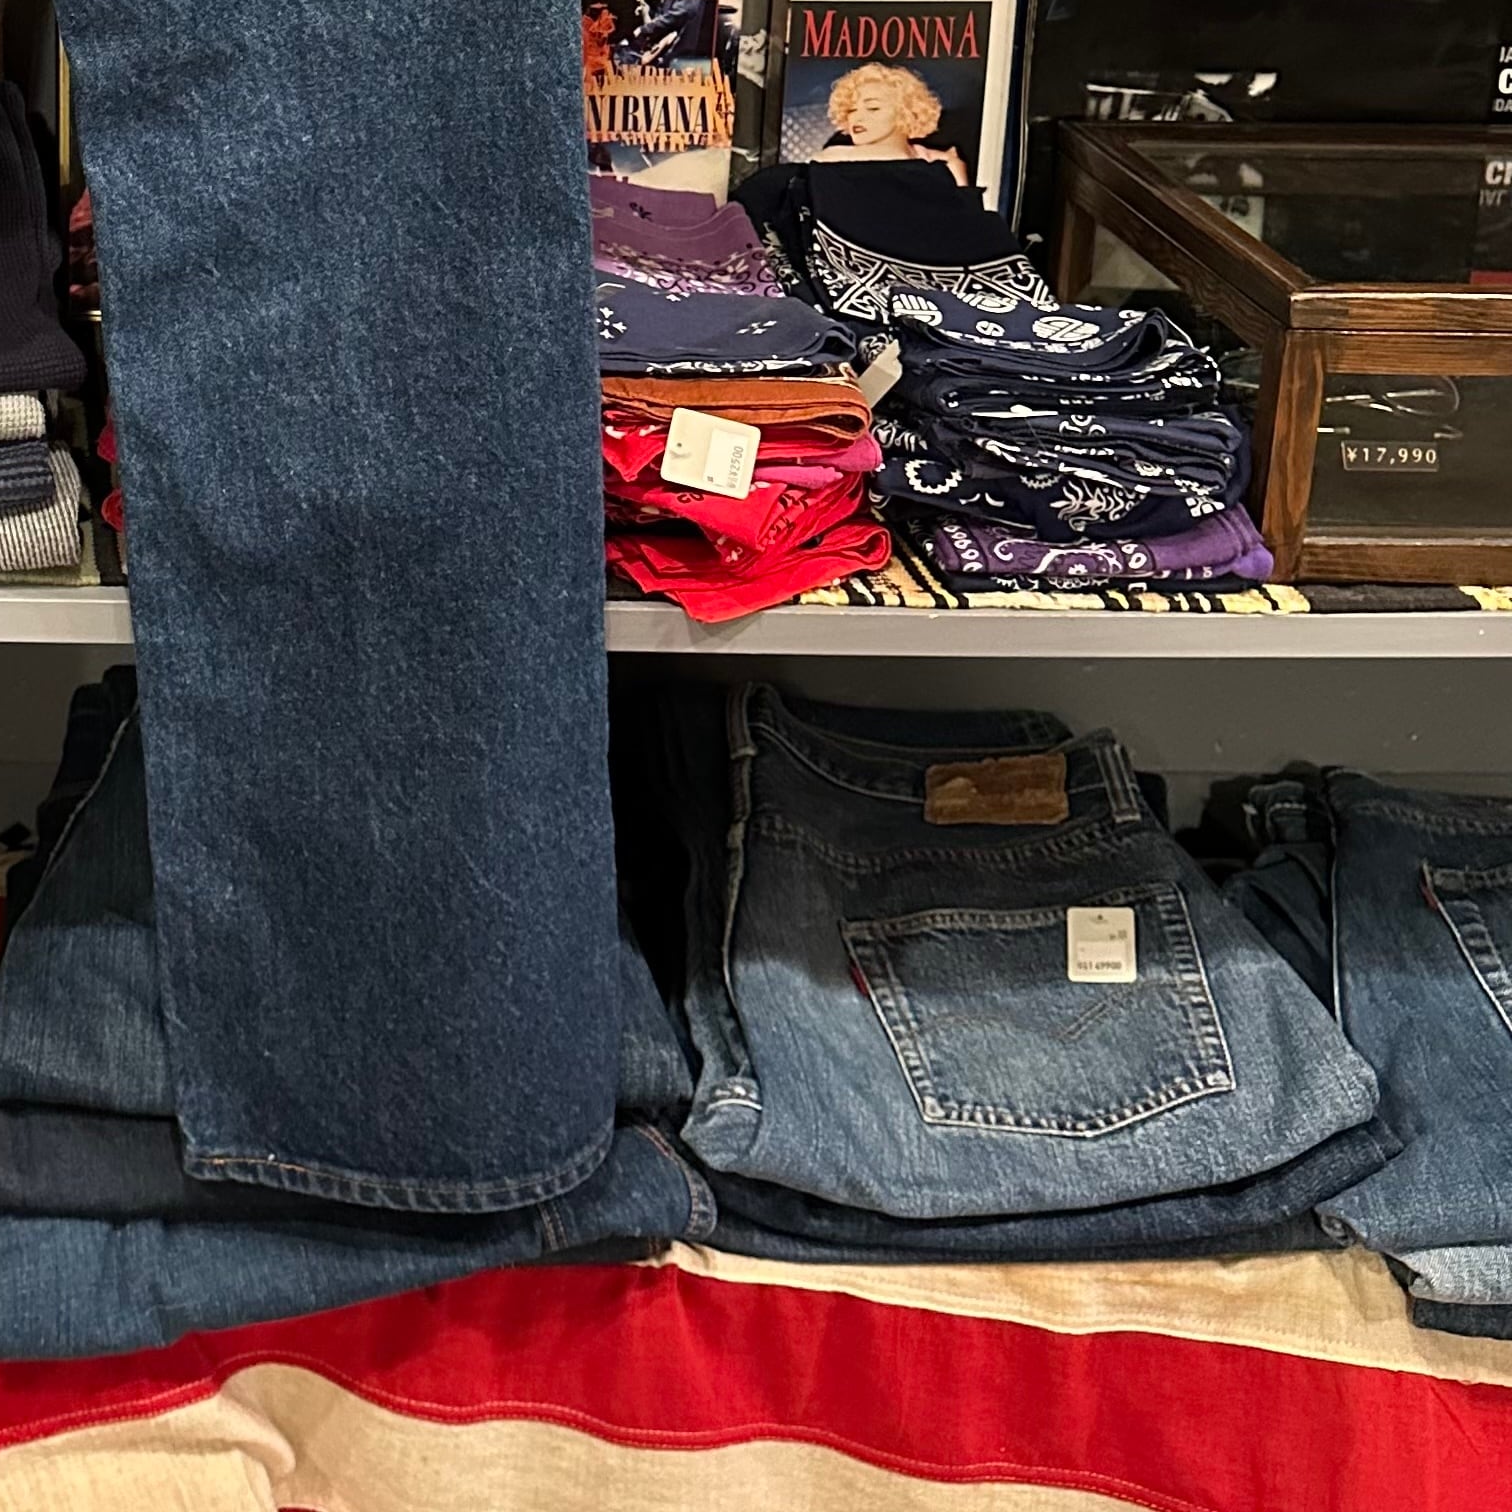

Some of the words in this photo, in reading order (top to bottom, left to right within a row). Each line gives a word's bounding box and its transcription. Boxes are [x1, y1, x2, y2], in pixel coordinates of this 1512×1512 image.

[800, 9, 981, 59] MADONNA
[587, 94, 710, 134] NIRVANA
[1346, 447, 1437, 465] ¥17,990
